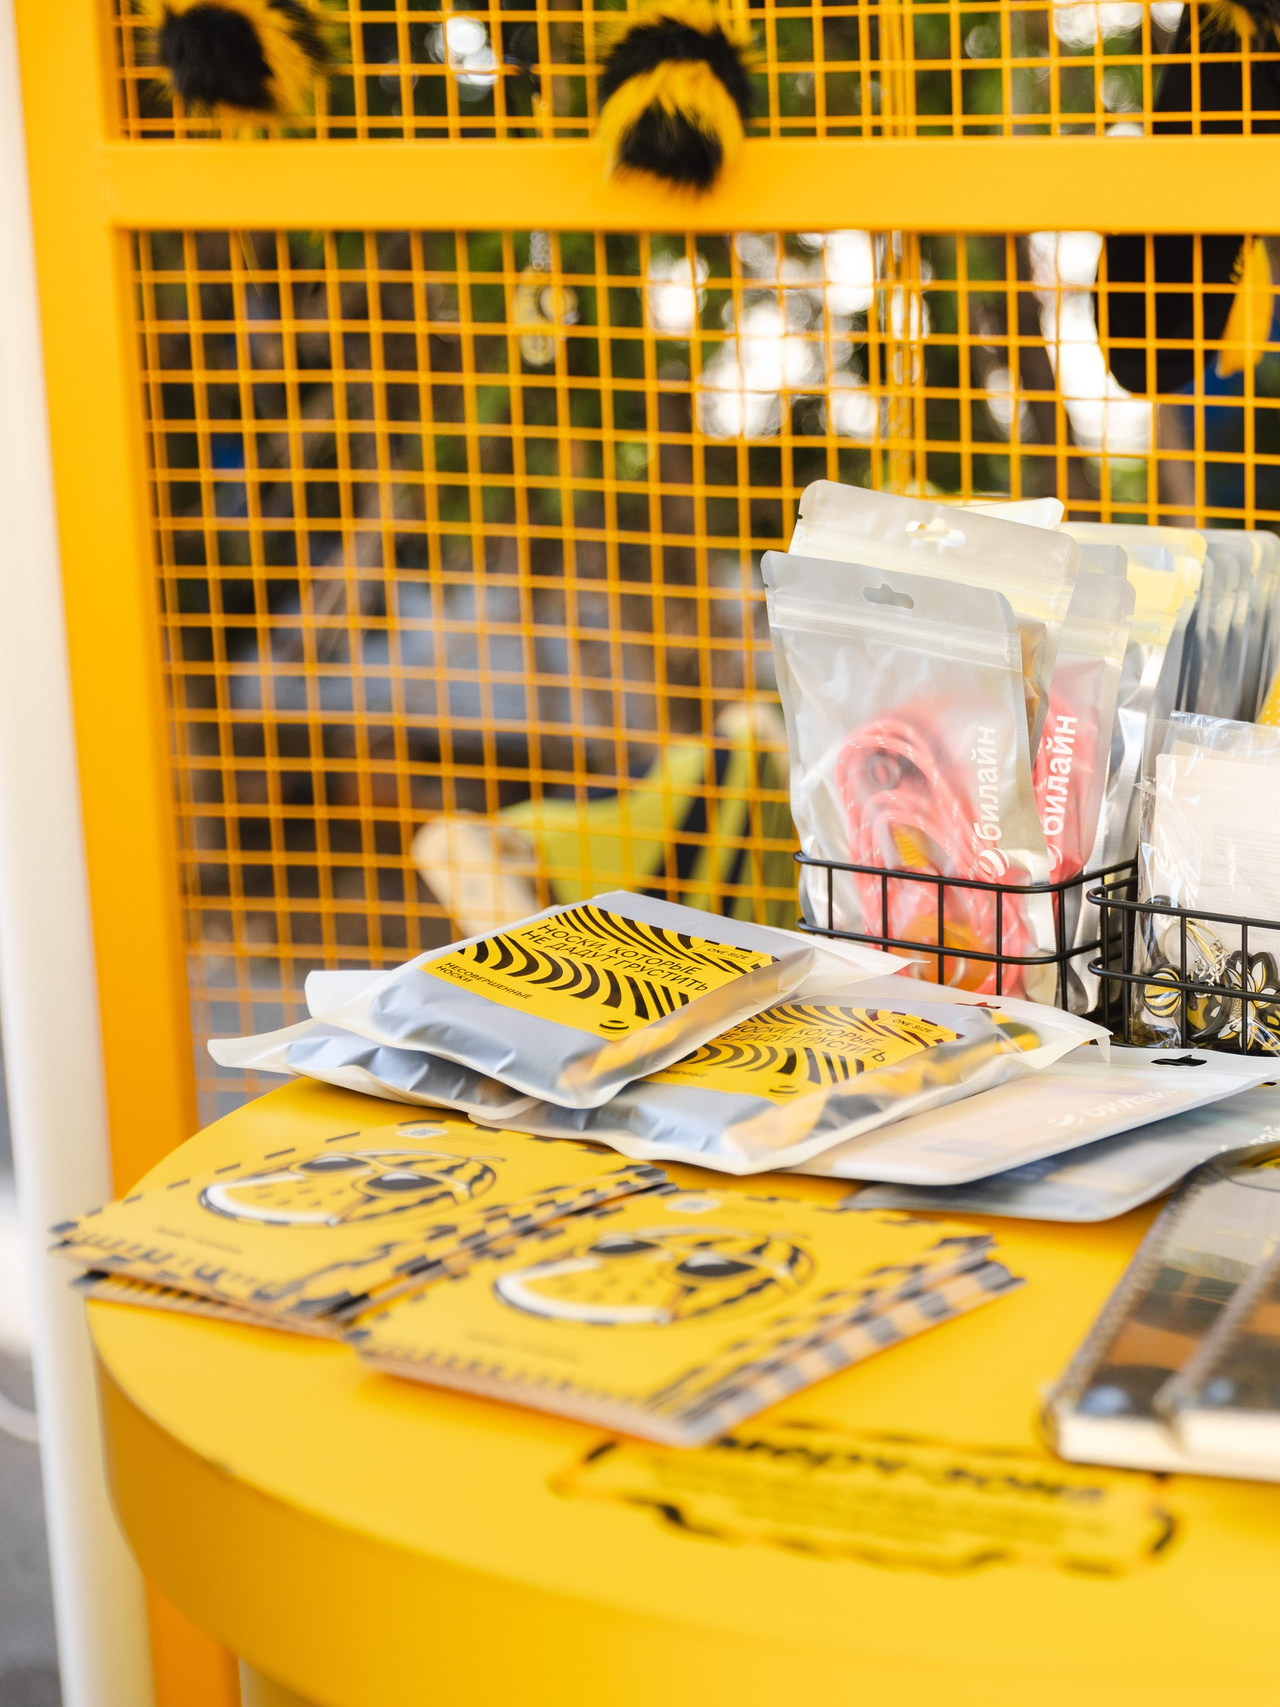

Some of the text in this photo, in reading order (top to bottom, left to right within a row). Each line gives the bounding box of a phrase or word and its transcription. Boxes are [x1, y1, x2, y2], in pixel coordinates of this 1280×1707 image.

[971, 726, 1002, 841] билайн
[1043, 715, 1078, 836] билайн
[521, 930, 709, 992] НЕ ДАДУТ ГРУСТИТЬ
[537, 924, 703, 975] НОСКИ, КОТОРЫЕ
[707, 947, 750, 961] ONE SIZE
[436, 965, 474, 983] НОСКИ
[445, 962, 533, 999] НЕСОВЕРШЕННЫЕ
[799, 1027, 883, 1047] КОТОРЫЕ
[892, 1018, 934, 1034] ONE SIZE
[736, 1033, 798, 1043] ДАДУТ
[802, 1035, 887, 1063] ГРУСТИТЬ
